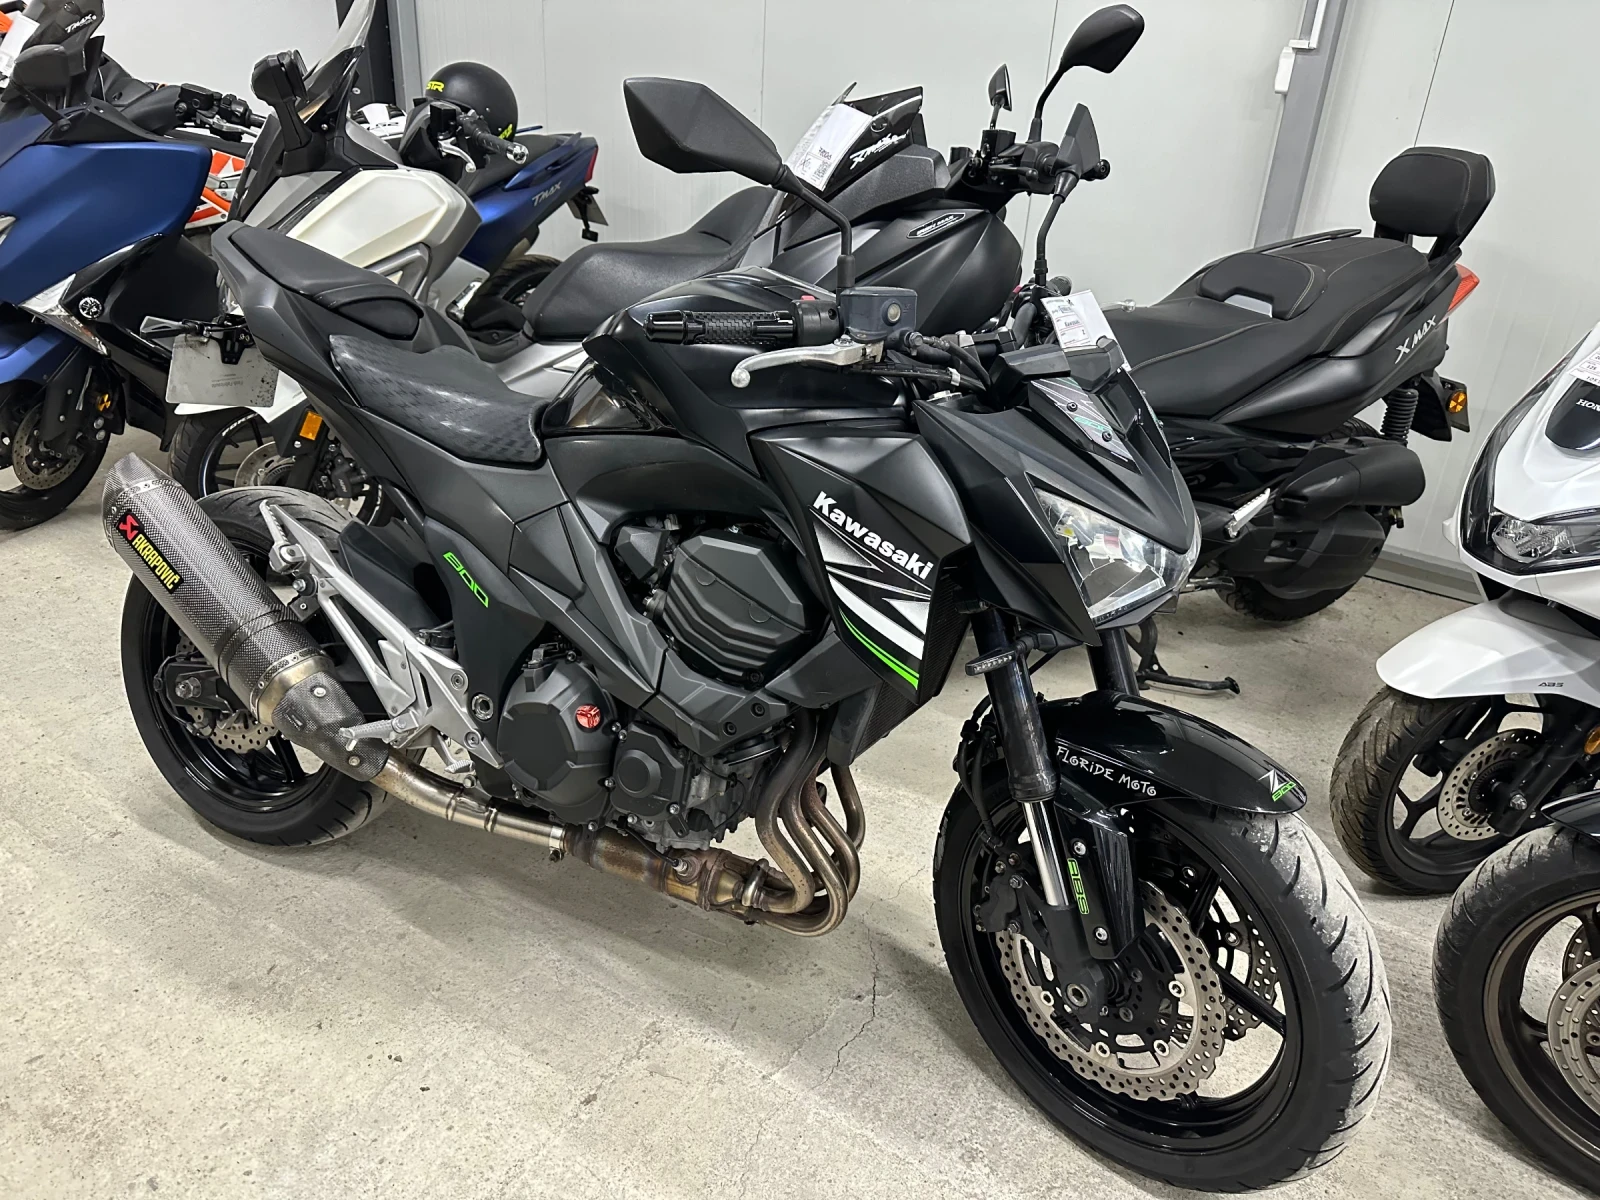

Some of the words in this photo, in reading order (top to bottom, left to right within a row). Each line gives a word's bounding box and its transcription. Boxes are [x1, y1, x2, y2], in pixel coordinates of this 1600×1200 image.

[813, 491, 934, 580] Kawasaki
[442, 551, 489, 608] 800
[1067, 857, 1090, 915] ABS
